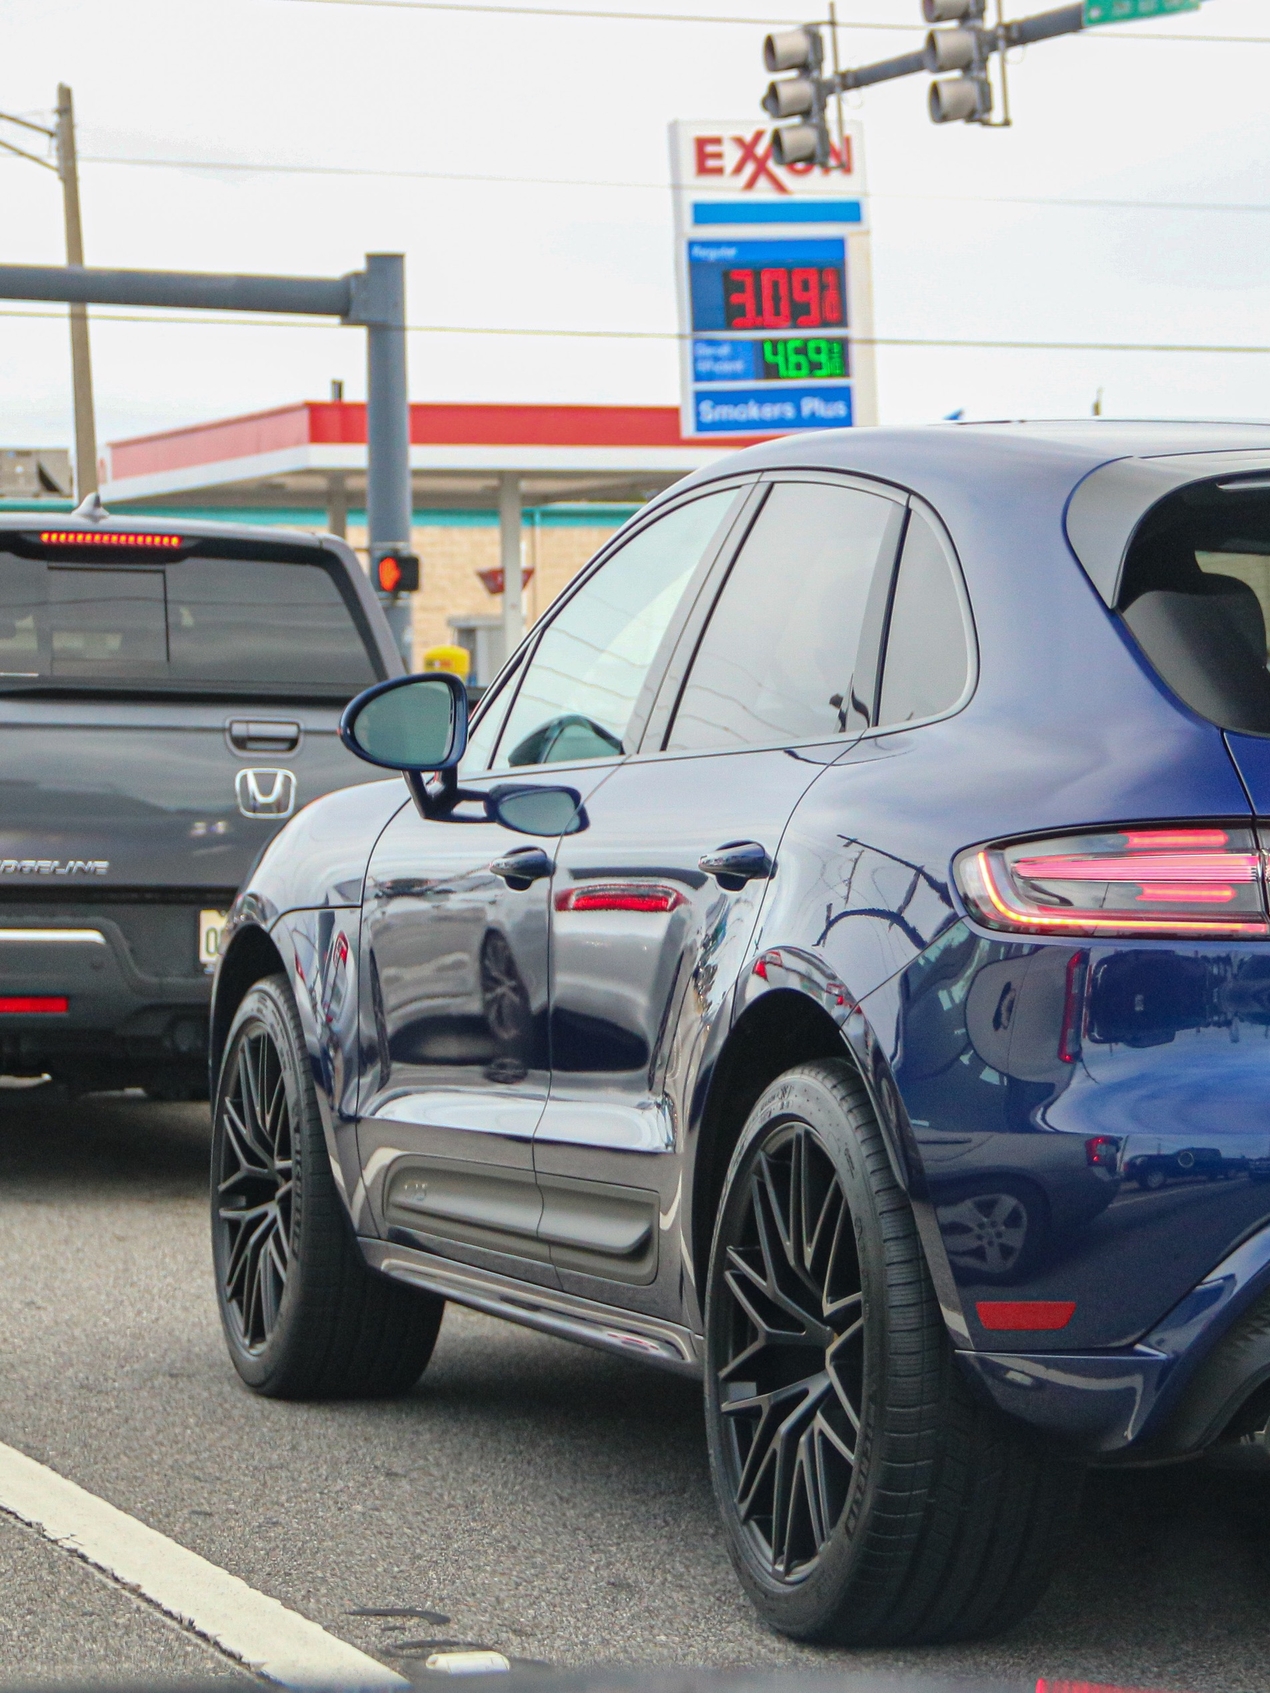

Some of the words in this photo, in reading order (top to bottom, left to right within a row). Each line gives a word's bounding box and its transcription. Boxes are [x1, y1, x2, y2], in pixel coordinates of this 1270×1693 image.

[694, 129, 853, 194] EXXN
[699, 399, 796, 424] Smokers
[801, 396, 848, 420] Plus
[0, 860, 109, 875] DGELINE
